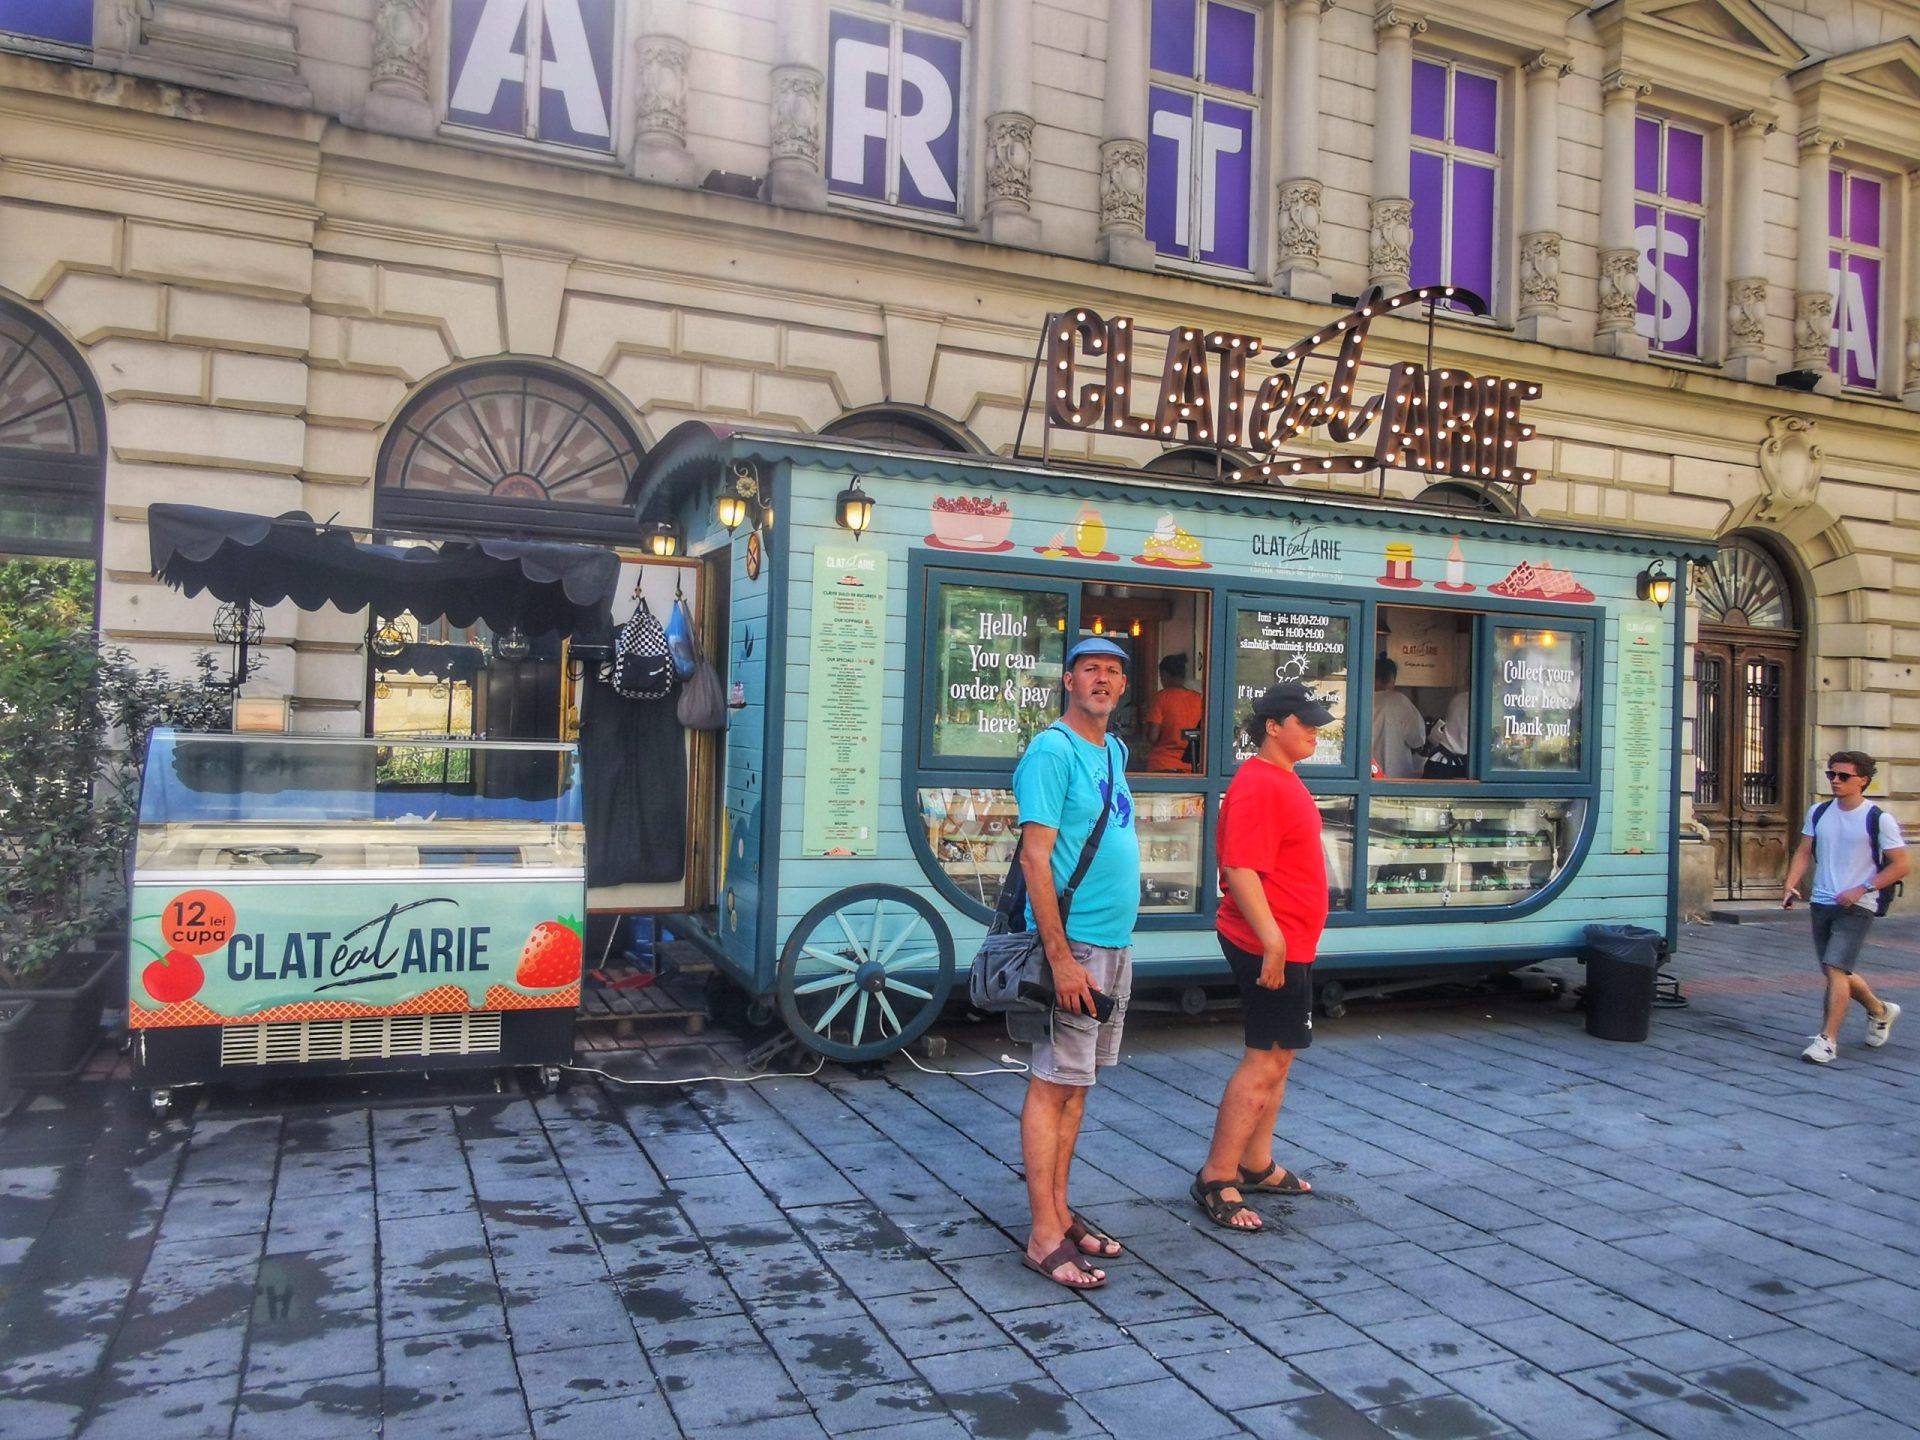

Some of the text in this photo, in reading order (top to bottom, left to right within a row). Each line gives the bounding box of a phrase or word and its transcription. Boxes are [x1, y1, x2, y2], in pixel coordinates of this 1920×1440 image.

[450, 0, 611, 138] A
[831, 38, 957, 203] R
[1152, 110, 1243, 253] T
[1634, 225, 1692, 342] S
[979, 612, 1028, 640] Hello!
[968, 644, 1035, 671] You can
[1504, 660, 1575, 686] Collect your
[950, 677, 1051, 708] order & pay
[1503, 687, 1573, 710] order here.
[978, 709, 1022, 733] here.
[1504, 715, 1571, 741] Thank you!
[173, 901, 226, 926] 12 lei
[172, 930, 226, 945] cupa
